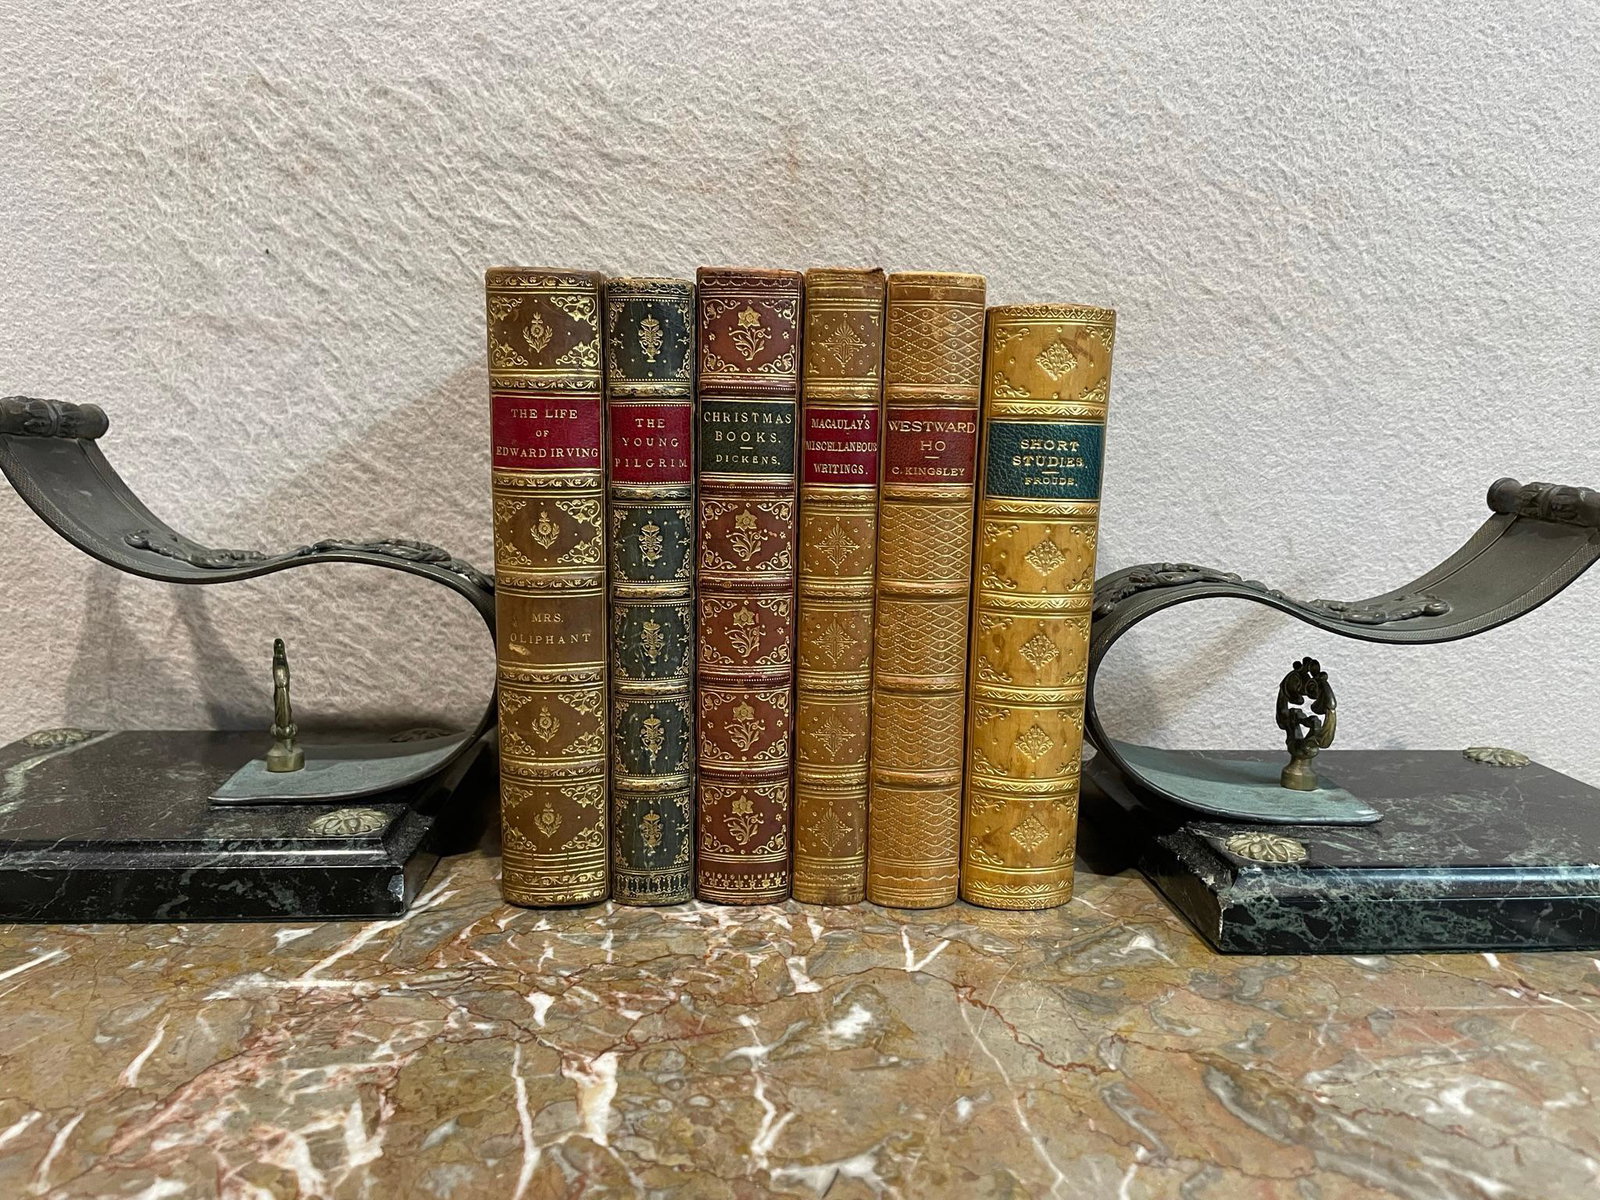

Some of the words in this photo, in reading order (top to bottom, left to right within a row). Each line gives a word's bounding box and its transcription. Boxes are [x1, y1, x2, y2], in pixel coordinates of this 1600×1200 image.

[511, 408, 538, 419] THE
[545, 408, 578, 420] LIFE
[703, 411, 792, 424] CHRISTMAS
[635, 418, 666, 428] THE
[888, 420, 976, 434] WESTWARD
[535, 429, 550, 438] OF
[715, 431, 782, 444] BOOKS.
[621, 437, 680, 447] YOUNG
[805, 440, 878, 452] MISCELLANEOUS
[920, 440, 947, 452] HO
[1020, 439, 1080, 452] SHORT
[496, 446, 547, 458] EDWARD
[550, 448, 599, 459] IRVING
[614, 457, 688, 468] PILGRIM
[716, 454, 781, 465] DICKENS.
[1012, 455, 1088, 469] STUDIES.
[813, 463, 869, 475] WRITINGS.
[904, 466, 966, 477] KINGSLEY
[1024, 477, 1078, 487] FROUDE.
[531, 613, 564, 623] MRS.
[510, 633, 591, 645] OLIPHANT
